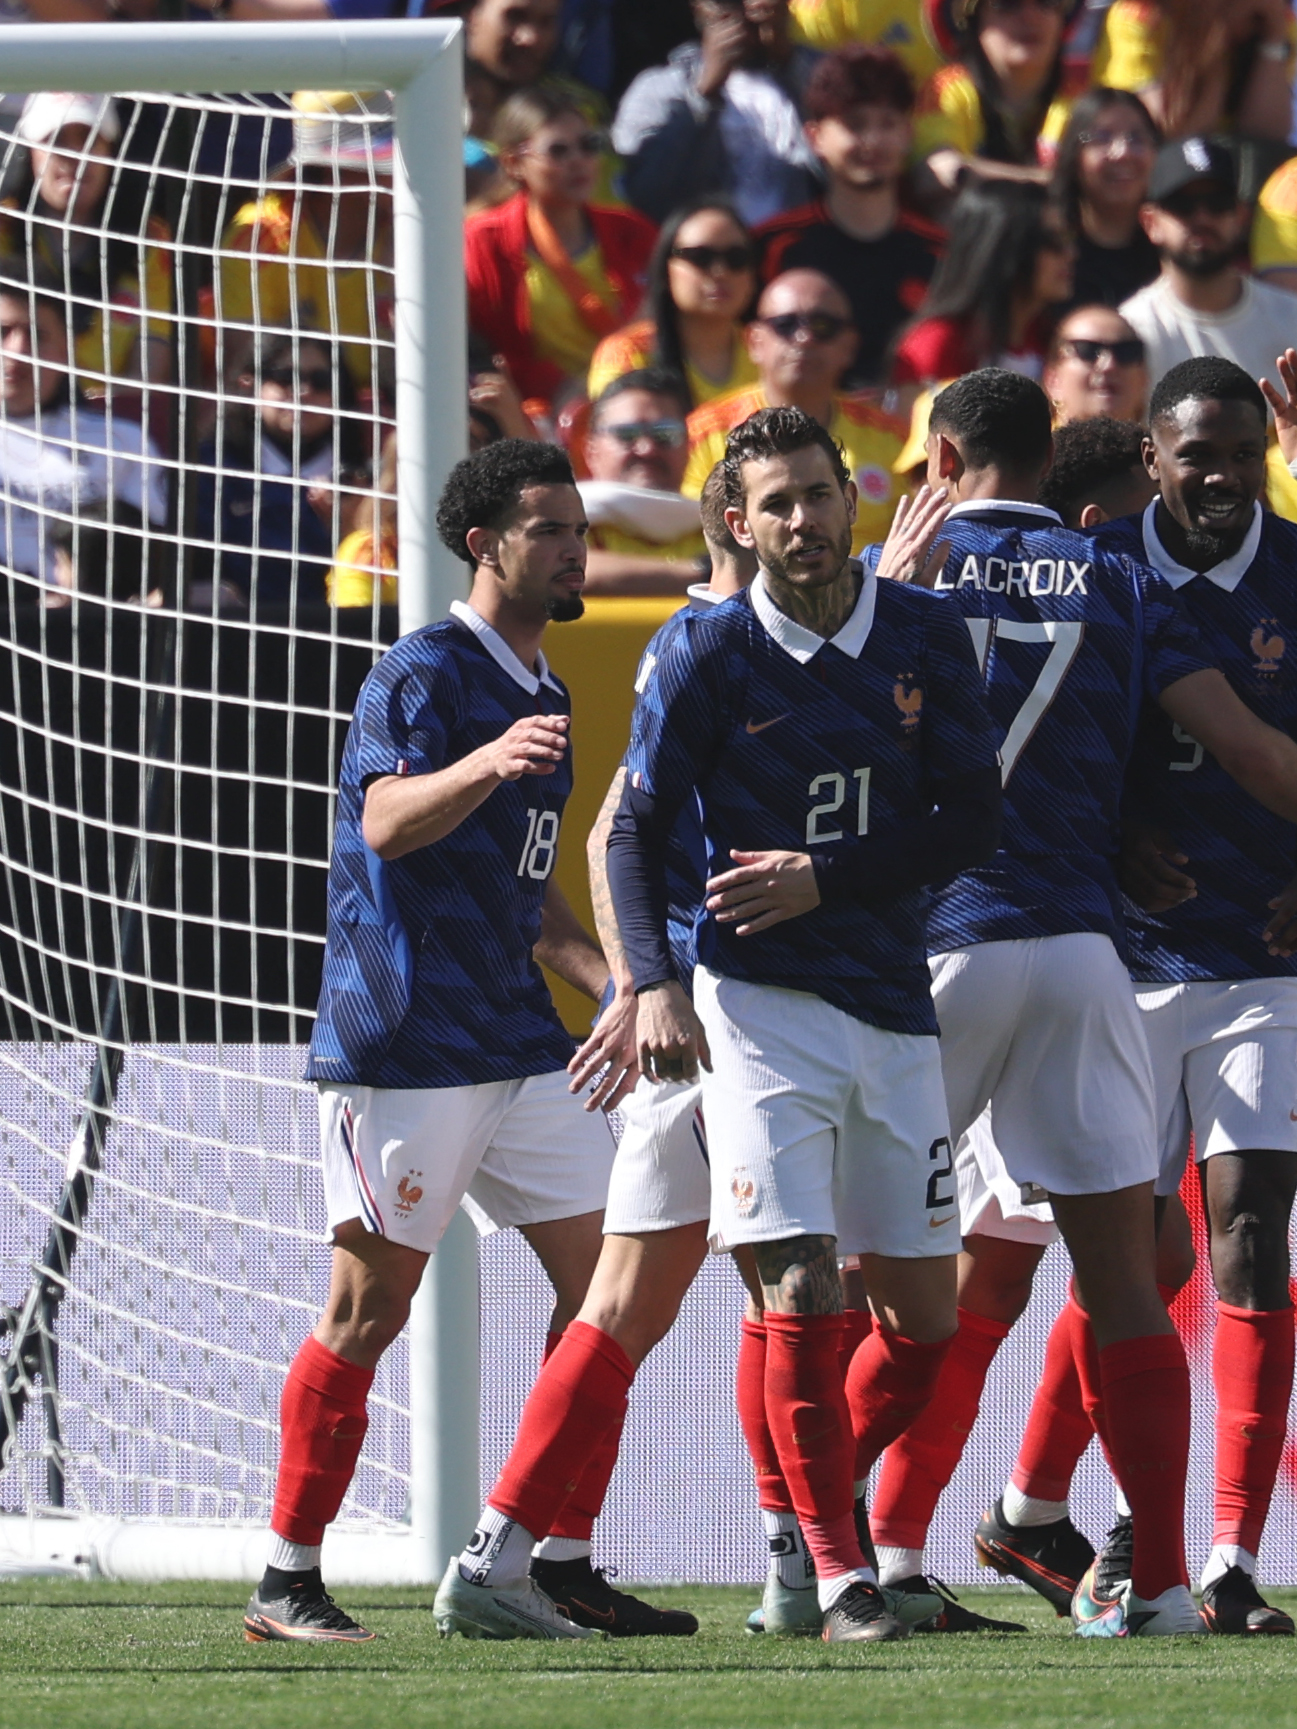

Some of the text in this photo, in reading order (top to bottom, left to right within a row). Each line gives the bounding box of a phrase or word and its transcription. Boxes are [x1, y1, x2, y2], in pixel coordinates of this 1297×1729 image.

[934, 555, 1090, 597] LACROIX
[806, 767, 871, 845] 21
[517, 808, 559, 880] 18
